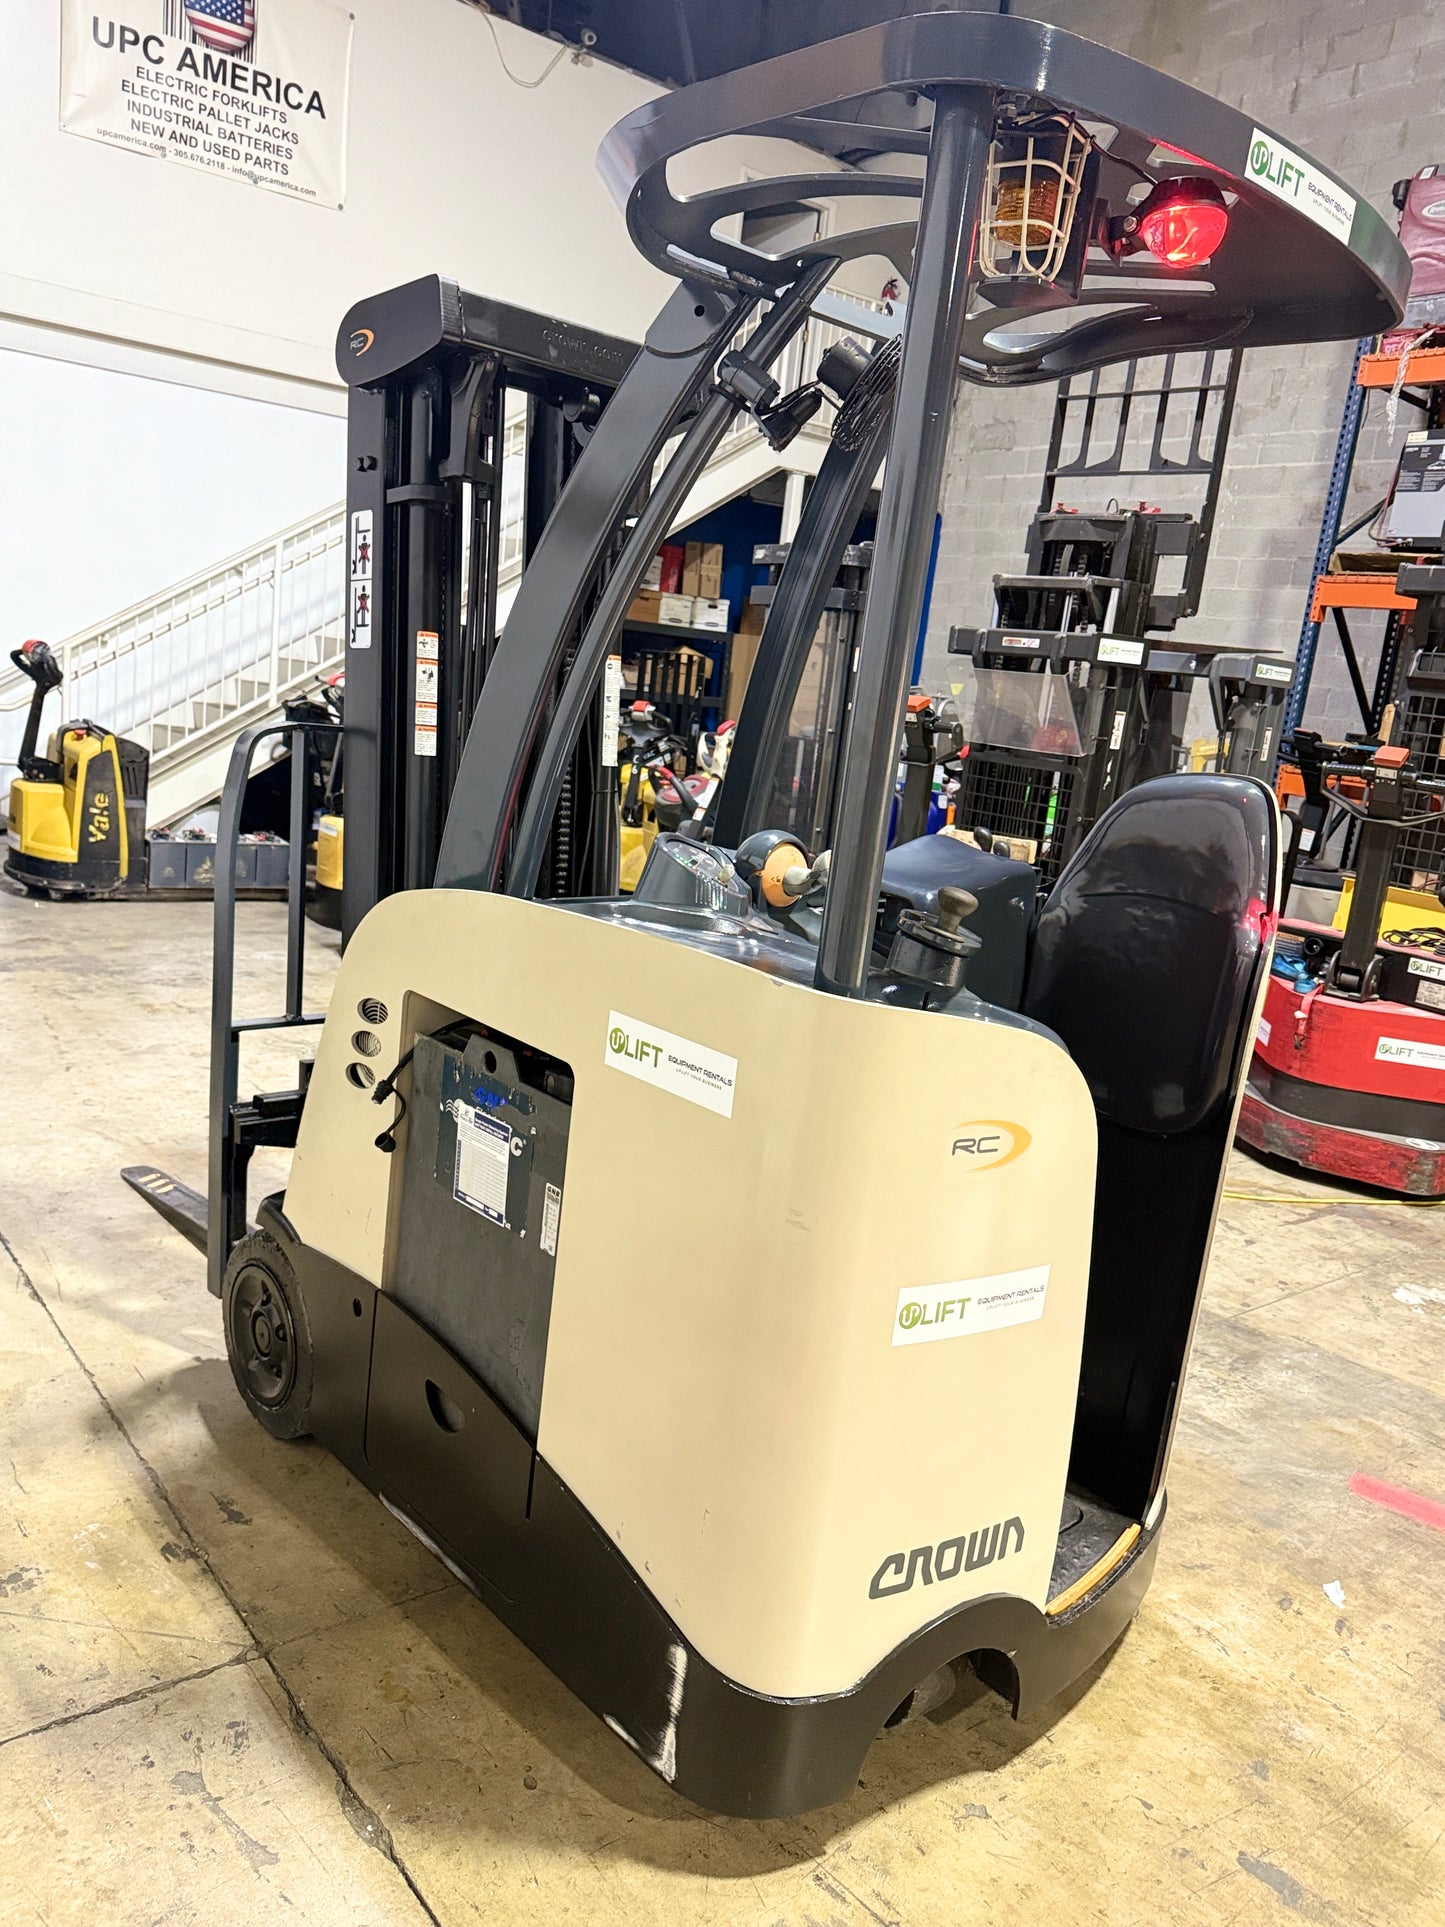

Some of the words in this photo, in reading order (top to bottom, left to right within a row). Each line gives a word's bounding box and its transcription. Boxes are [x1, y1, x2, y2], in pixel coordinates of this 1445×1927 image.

[93, 16, 165, 65] UPC
[176, 46, 326, 119] AMERICA
[136, 66, 208, 98] ELECTRIC
[212, 89, 287, 124] FORKLIFTS
[121, 79, 194, 112] ELECTRIC
[198, 103, 251, 129] PALLET
[254, 122, 299, 145] JACKS
[127, 99, 213, 136] INDUSTRIAL
[217, 127, 293, 160] BATTERIES
[96, 128, 167, 153] upcamerica.com
[173, 149, 225, 170] 305.676.2118
[231, 166, 317, 197] info@upcamerica.com
[131, 118, 165, 138] NEW
[168, 130, 198, 148] AND
[203, 141, 240, 161] USED
[245, 152, 289, 176] PARTS
[88, 792, 110, 843] Yale
[668, 1054, 703, 1074] EQUIPMENT
[703, 1069, 733, 1087] RENTALS
[951, 1135, 1001, 1156] RC
[977, 1292, 1015, 1305] EQUIPMENT
[1016, 1285, 1045, 1297] RENTALS
[868, 1516, 1025, 1600] CROWN
